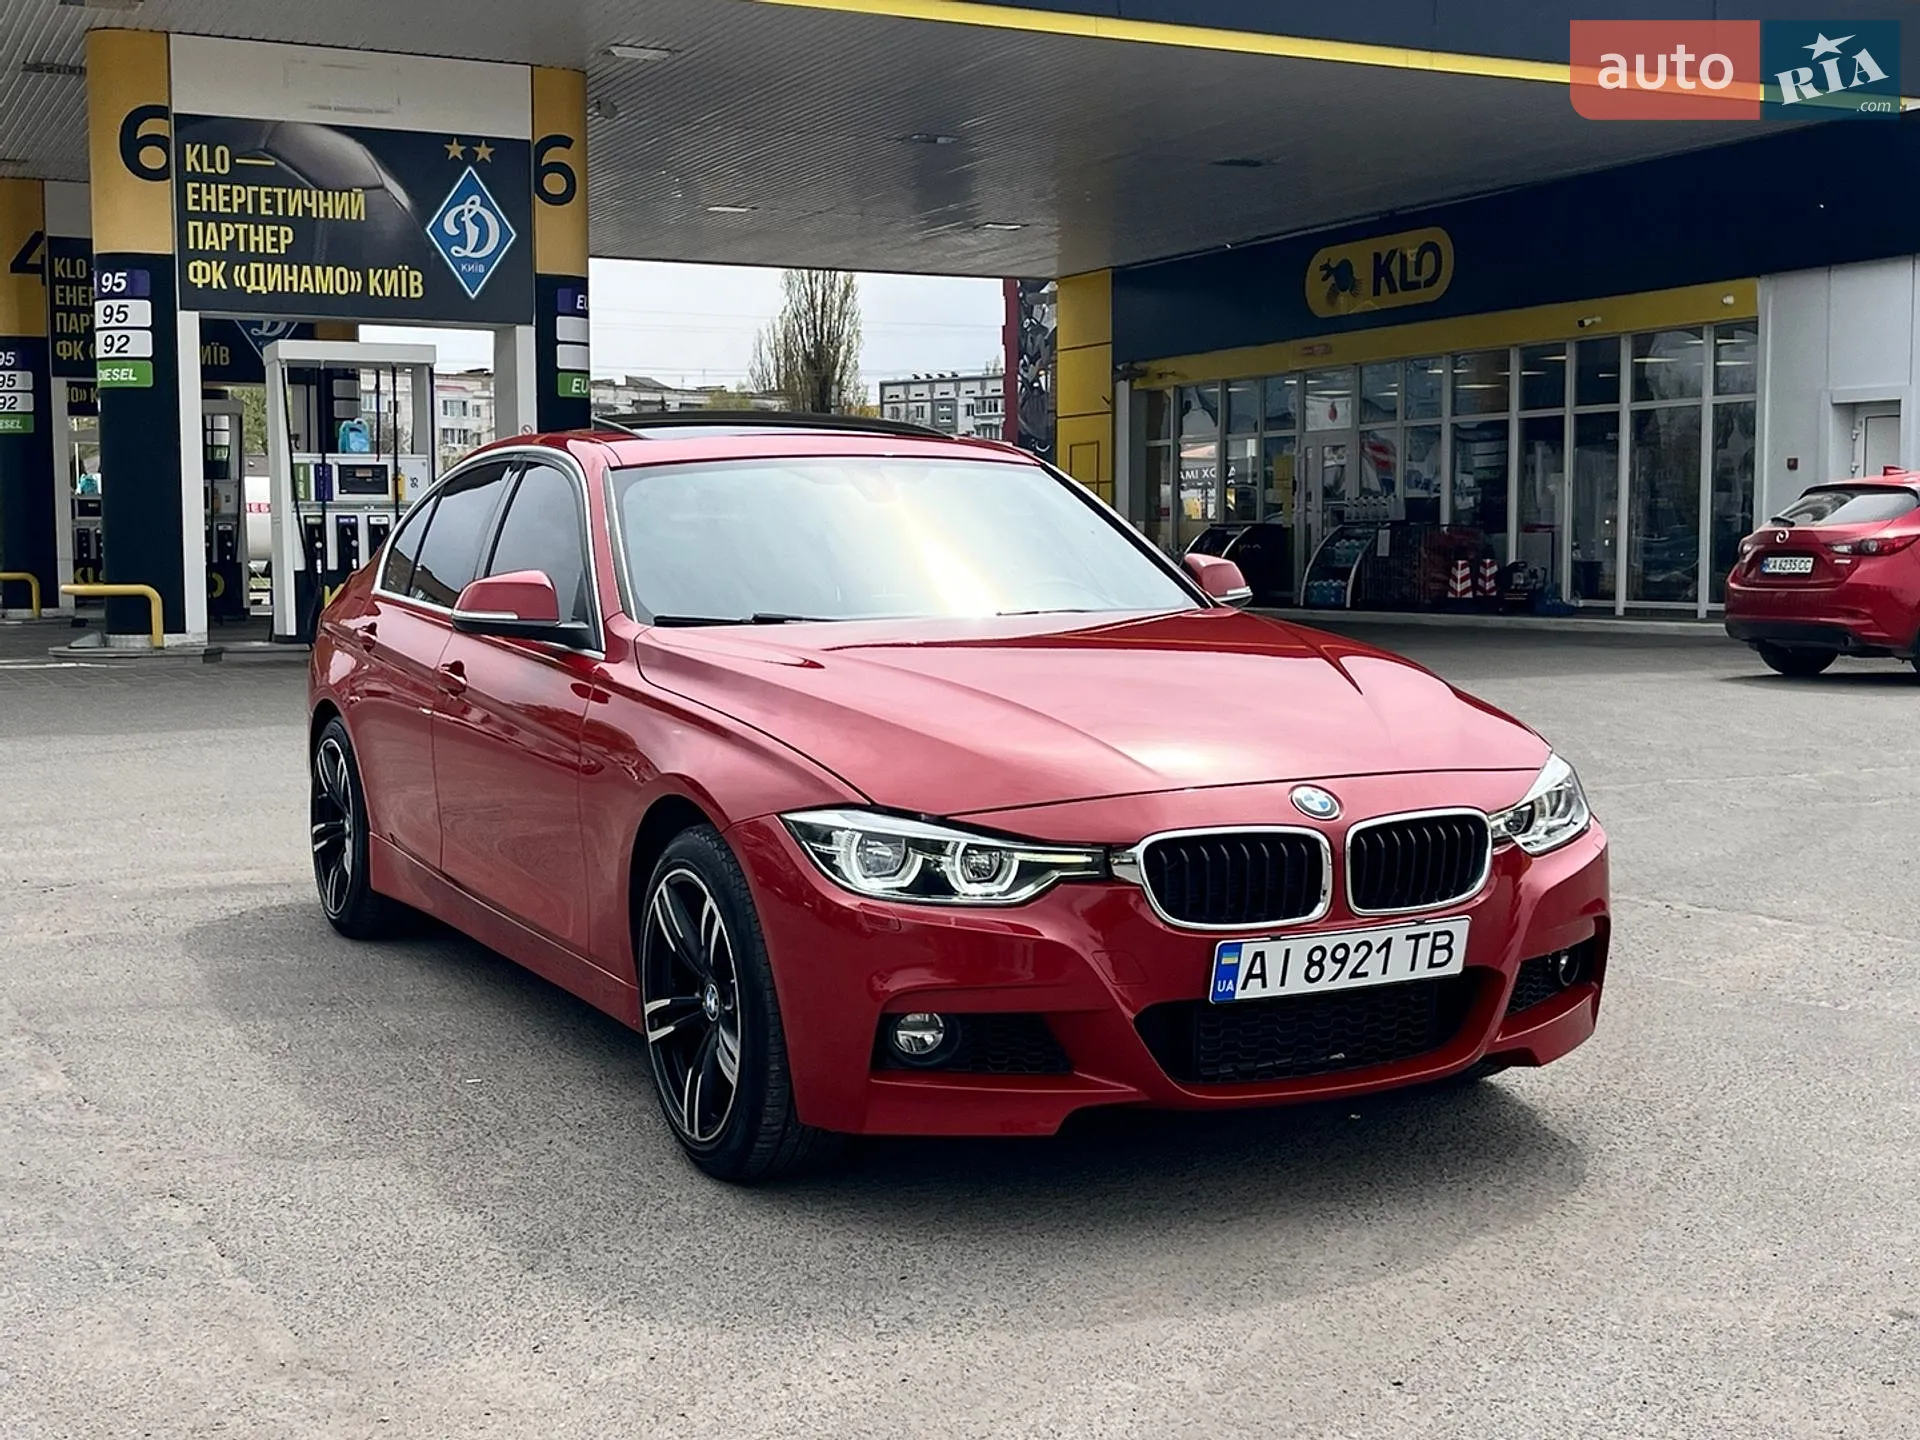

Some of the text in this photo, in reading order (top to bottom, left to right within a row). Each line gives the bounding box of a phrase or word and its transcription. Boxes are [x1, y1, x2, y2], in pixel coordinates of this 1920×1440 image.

[119, 103, 171, 182] 6
[185, 143, 231, 175] KLO
[534, 134, 577, 206] 6
[185, 182, 366, 221] ЕНЕРГЕТИЧНИЙ
[187, 220, 294, 254] ПАРТНЕР
[54, 257, 87, 279] KLO
[101, 272, 128, 294] 95
[188, 259, 424, 299] ФК «ДИНАМО» КИЇВ
[1373, 241, 1443, 297] KLO
[103, 304, 130, 324] 95
[103, 334, 131, 355] 92
[1240, 929, 1455, 991] AI 8921 TB
[1217, 980, 1235, 992] UA
